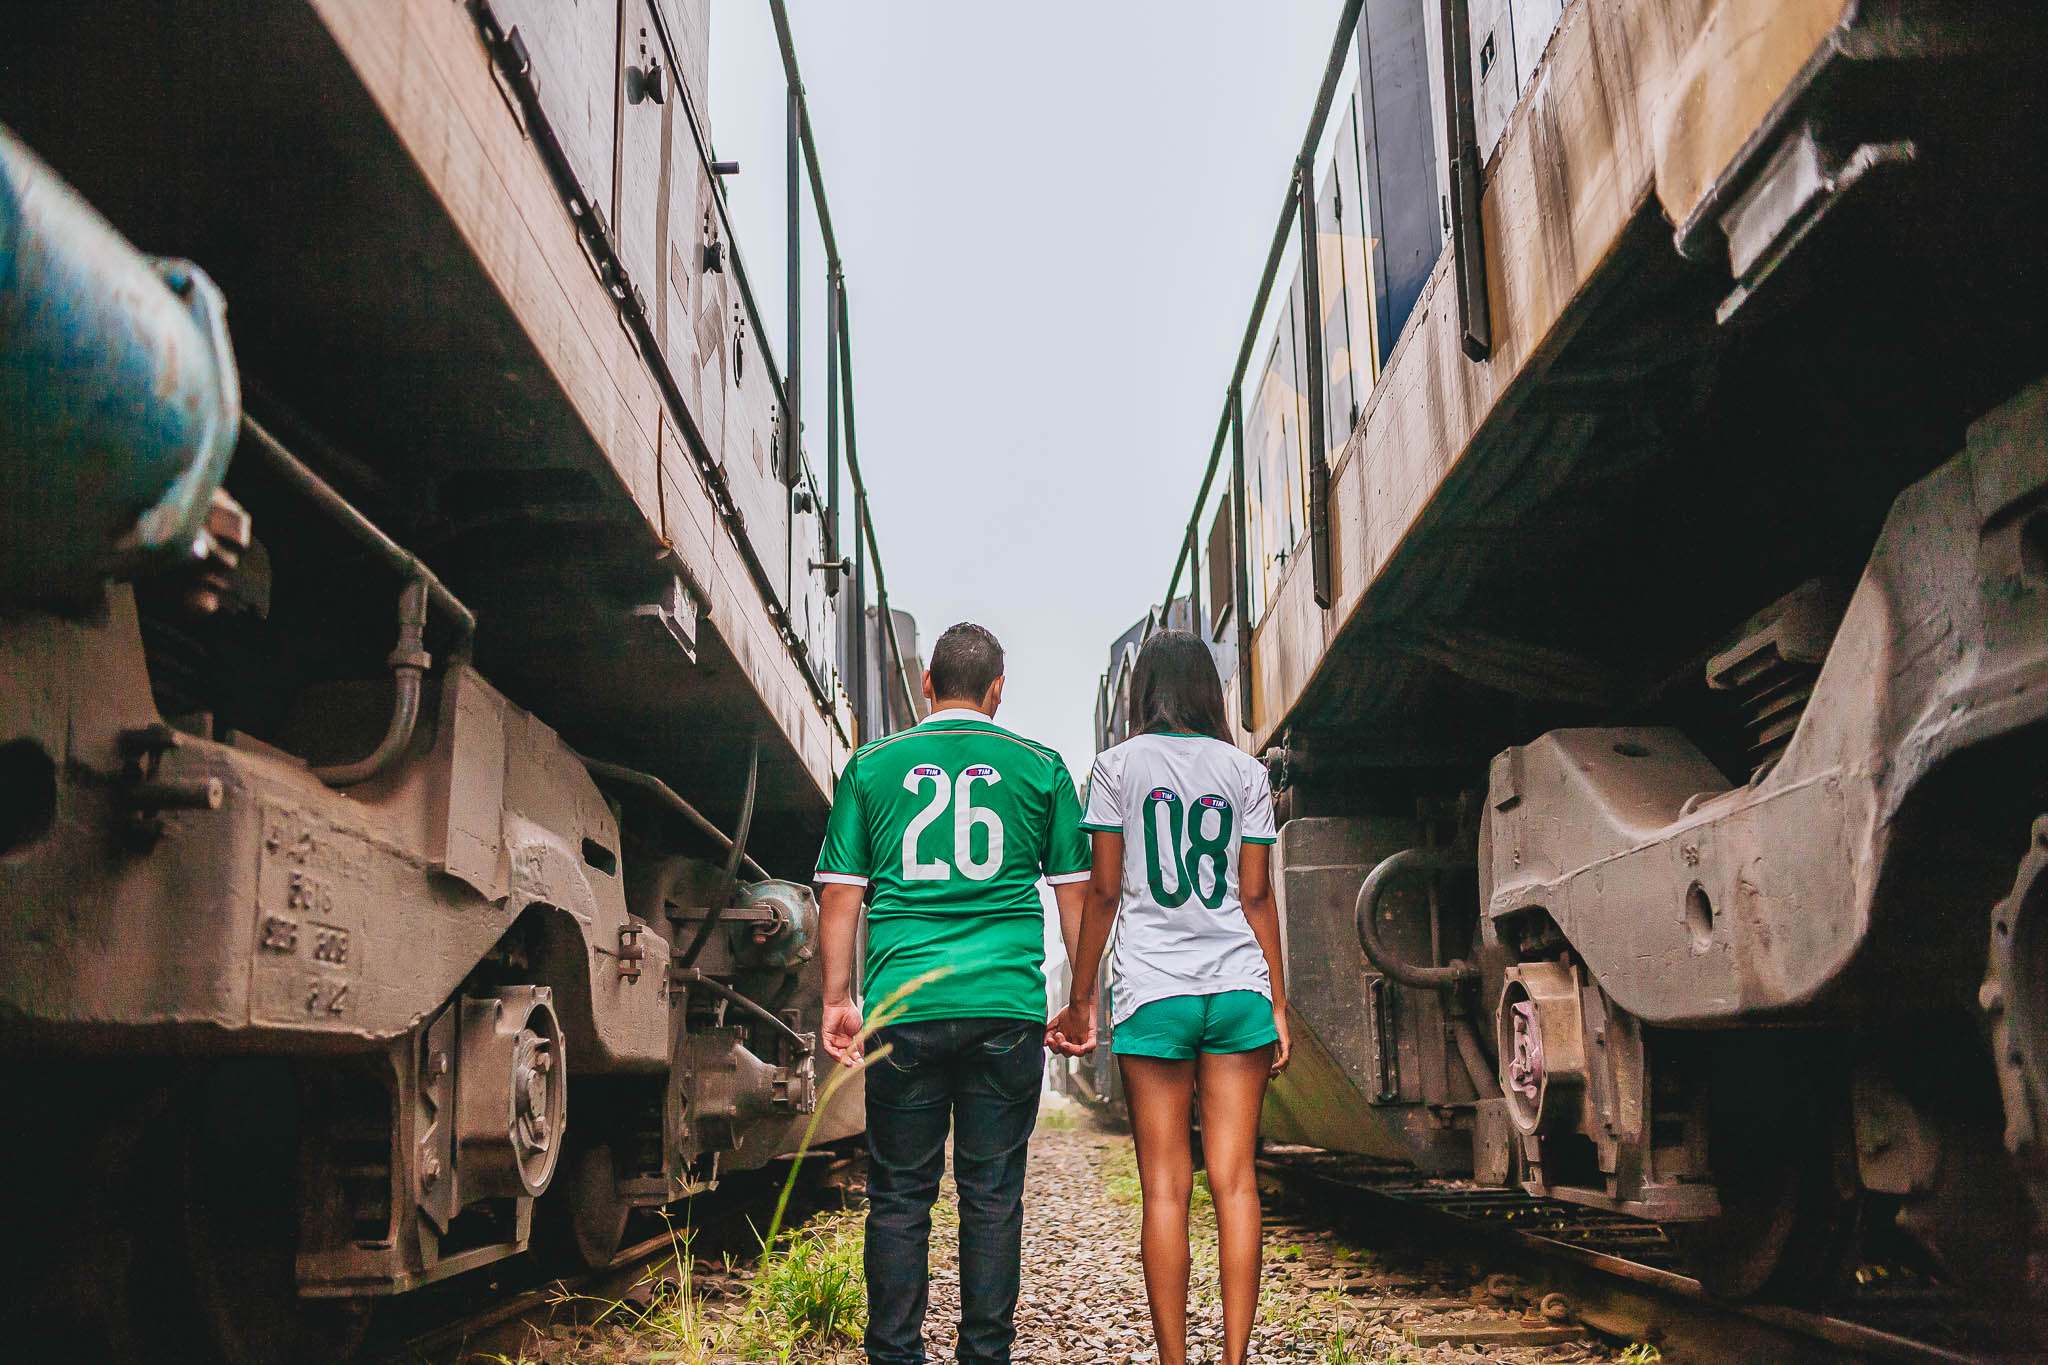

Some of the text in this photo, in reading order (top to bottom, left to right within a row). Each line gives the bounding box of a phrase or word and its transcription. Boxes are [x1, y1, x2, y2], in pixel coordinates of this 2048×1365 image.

[926, 768, 939, 776] TIM
[977, 768, 991, 776] TIM
[1161, 792, 1173, 801] TIM
[1211, 799, 1225, 808] TIM
[902, 763, 1004, 880] 26
[1143, 787, 1233, 909] 08
